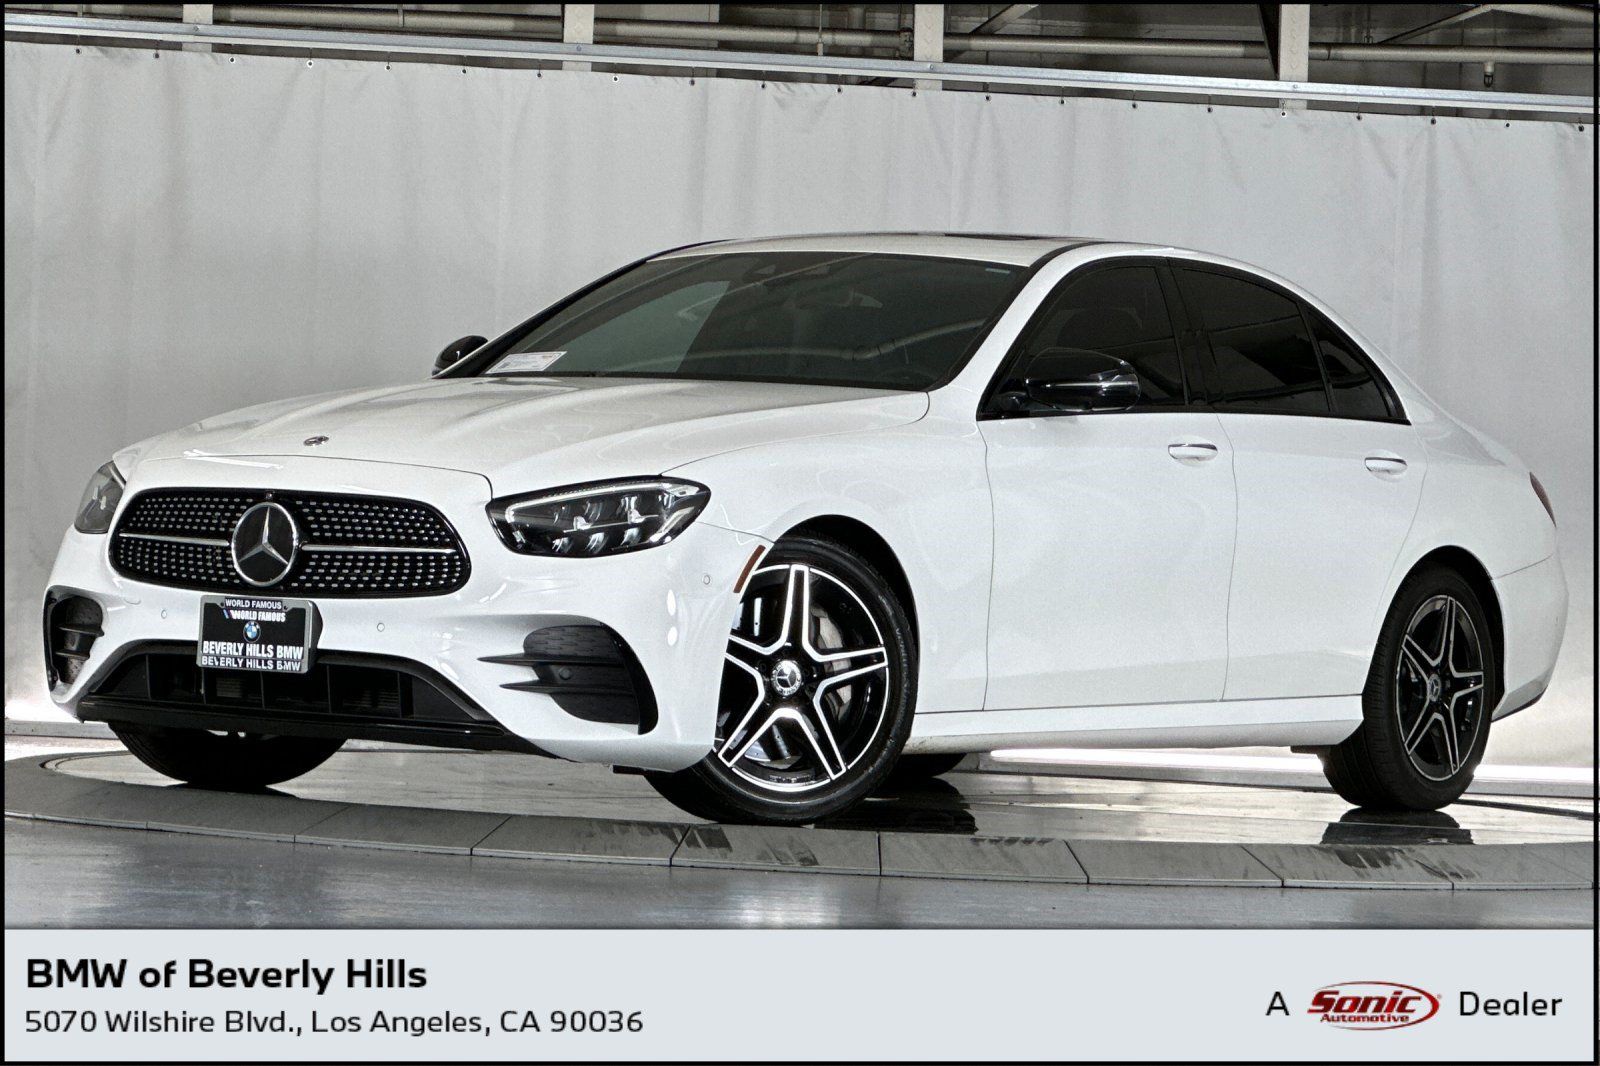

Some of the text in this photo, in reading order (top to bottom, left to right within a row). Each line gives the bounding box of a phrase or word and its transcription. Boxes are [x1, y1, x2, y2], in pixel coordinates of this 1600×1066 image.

[225, 599, 282, 610] WORLD FAMOUS
[257, 611, 286, 622] FAMOUS
[203, 641, 303, 660] BEVERLY HILLS BMW
[201, 656, 301, 672] BEVERLY HILLS BMW
